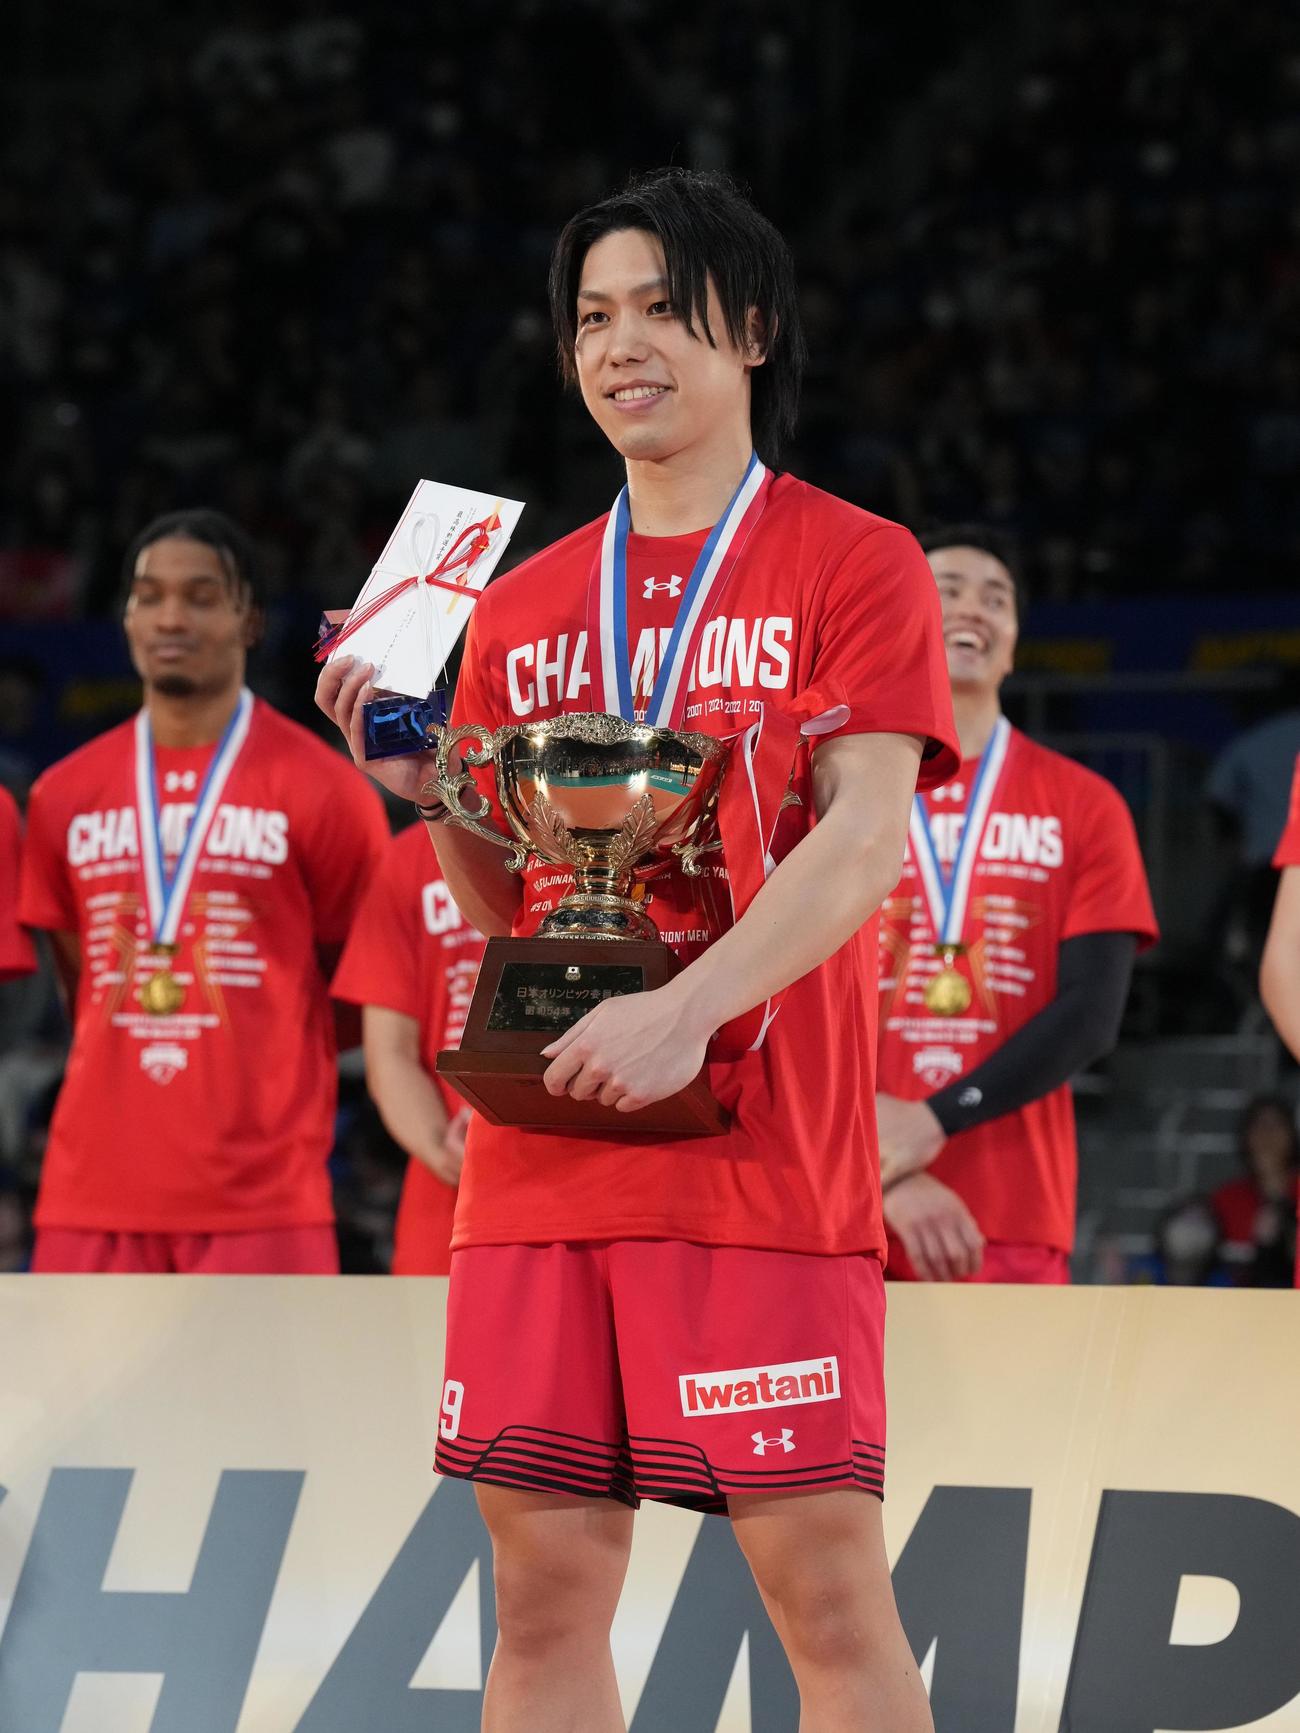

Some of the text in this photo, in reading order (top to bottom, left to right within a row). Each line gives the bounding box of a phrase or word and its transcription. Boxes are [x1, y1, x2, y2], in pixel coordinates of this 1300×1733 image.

[686, 703, 702, 718] 2007
[708, 698, 723, 712] 2021
[725, 701, 741, 714] 2022
[687, 929, 709, 942] MEN
[440, 1379, 465, 1441] 9
[686, 1361, 835, 1412] Iwatani
[0, 1466, 1300, 1733] HAMP
